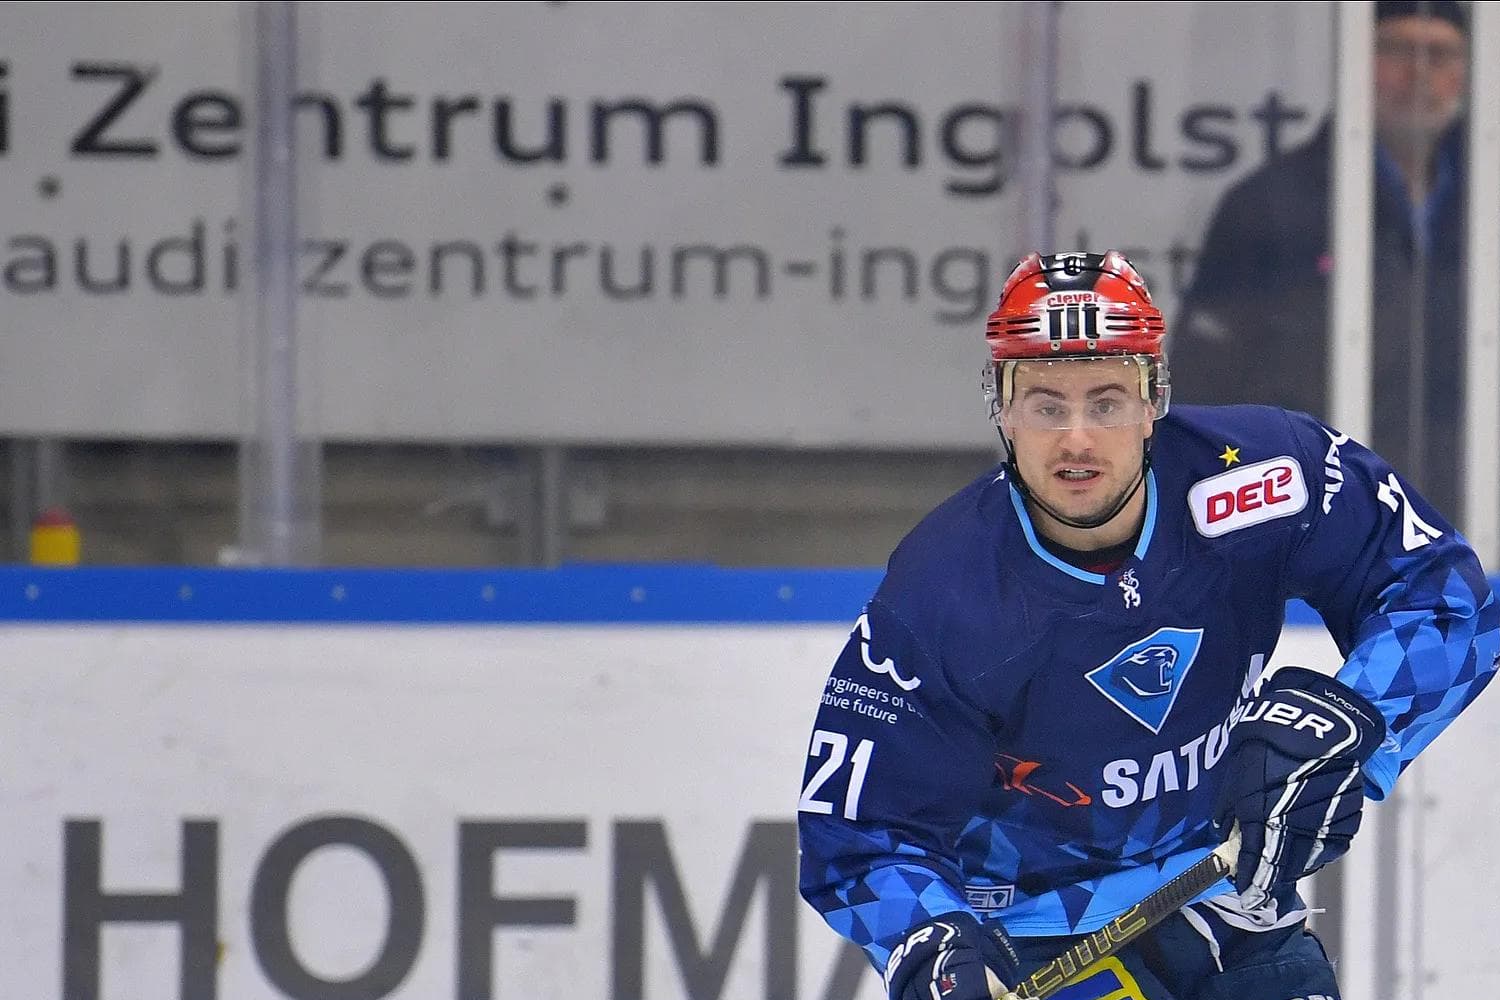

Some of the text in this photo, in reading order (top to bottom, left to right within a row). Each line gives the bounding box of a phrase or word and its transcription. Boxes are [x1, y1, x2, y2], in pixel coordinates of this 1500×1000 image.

[69, 61, 722, 168] Zentrum
[1047, 291, 1099, 306] clever
[1206, 467, 1293, 524] DEL
[852, 698, 898, 725] future
[1324, 687, 1360, 716] VAPOR
[797, 729, 875, 822] 21
